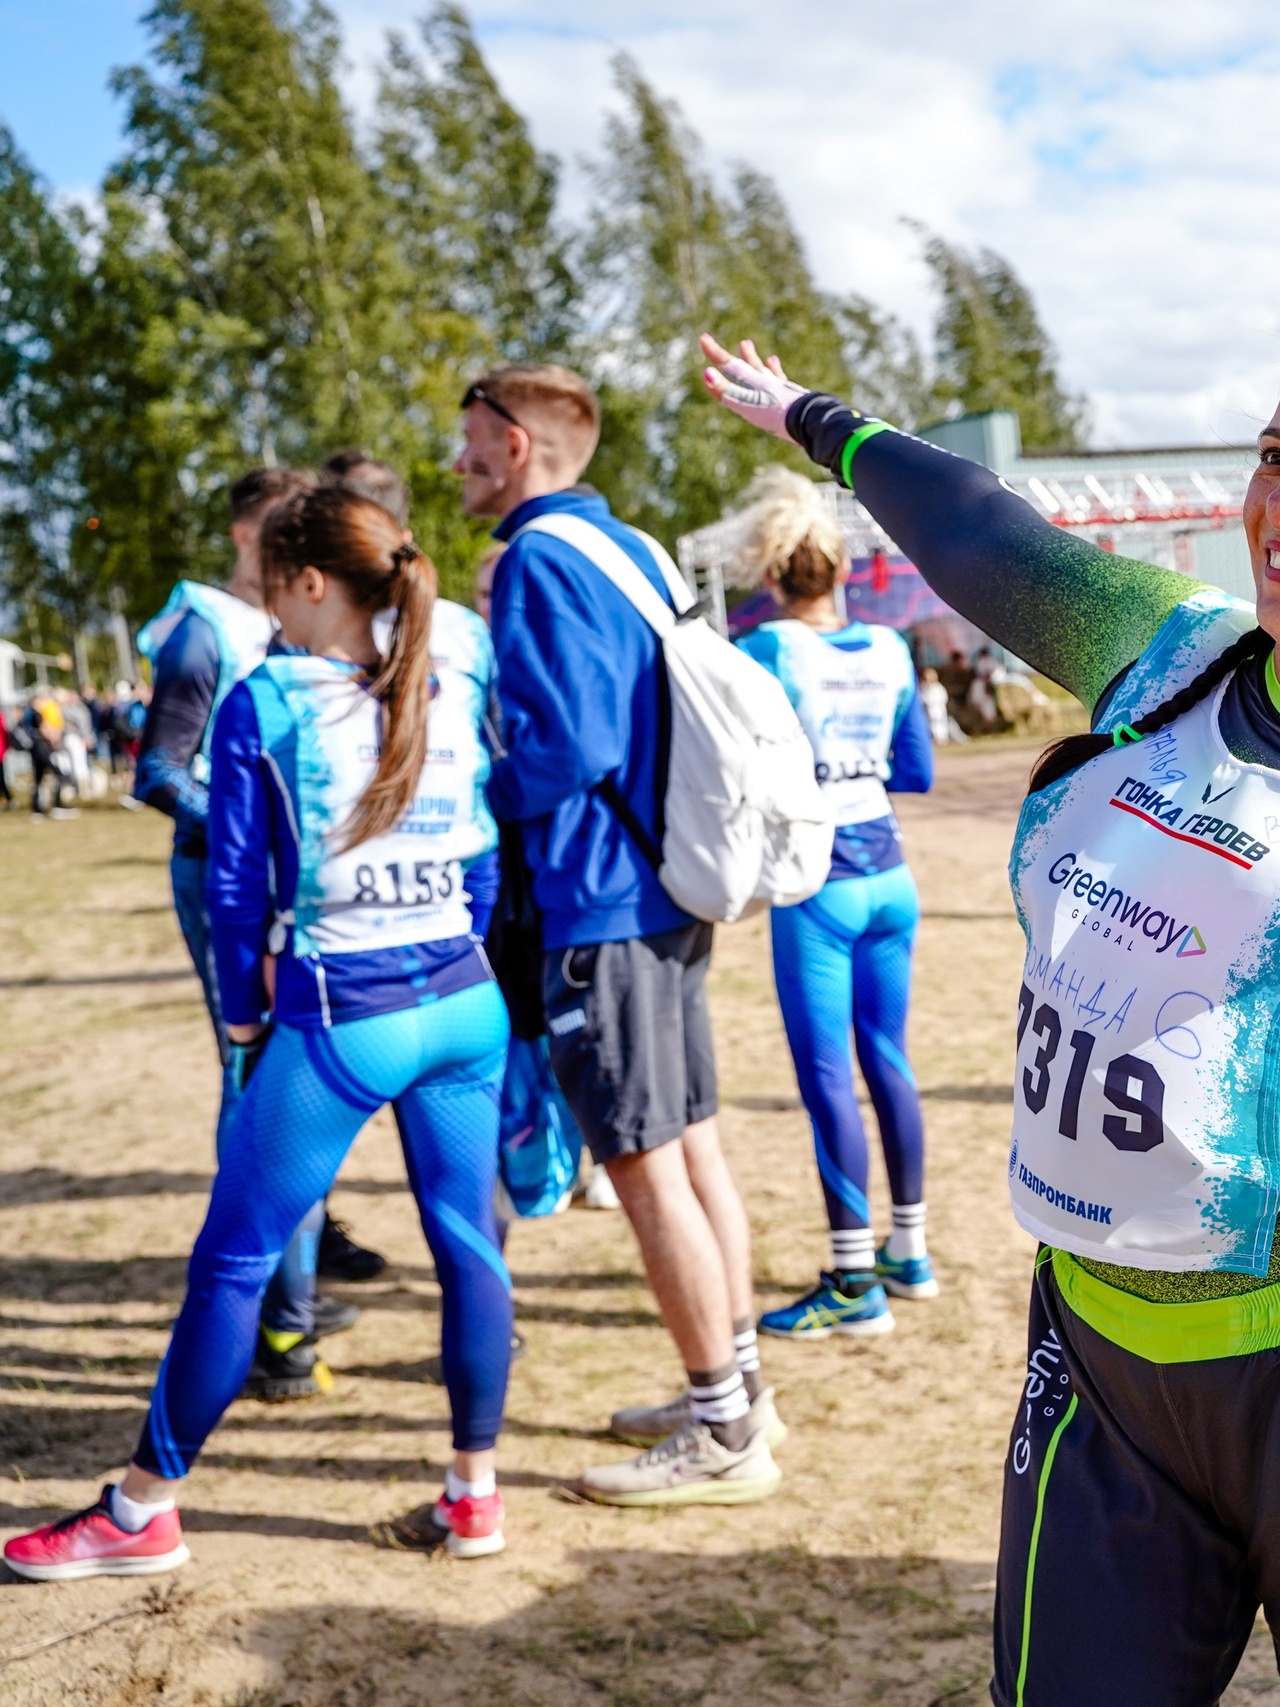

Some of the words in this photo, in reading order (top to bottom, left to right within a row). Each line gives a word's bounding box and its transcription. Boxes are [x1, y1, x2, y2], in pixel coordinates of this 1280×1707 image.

[1115, 776, 1184, 826] ГОНКА
[1179, 813, 1271, 862] ГЕРОЕВ
[1048, 852, 1190, 954] Greenway
[1071, 908, 1135, 952] GLOBAL
[1026, 945, 1138, 1034] ОМАНДА
[1154, 990, 1215, 1060] 6
[1016, 980, 1166, 1153] 7319
[1018, 1162, 1113, 1225] ГАЗПРОМБАНК
[1043, 1373, 1069, 1417] GLO
